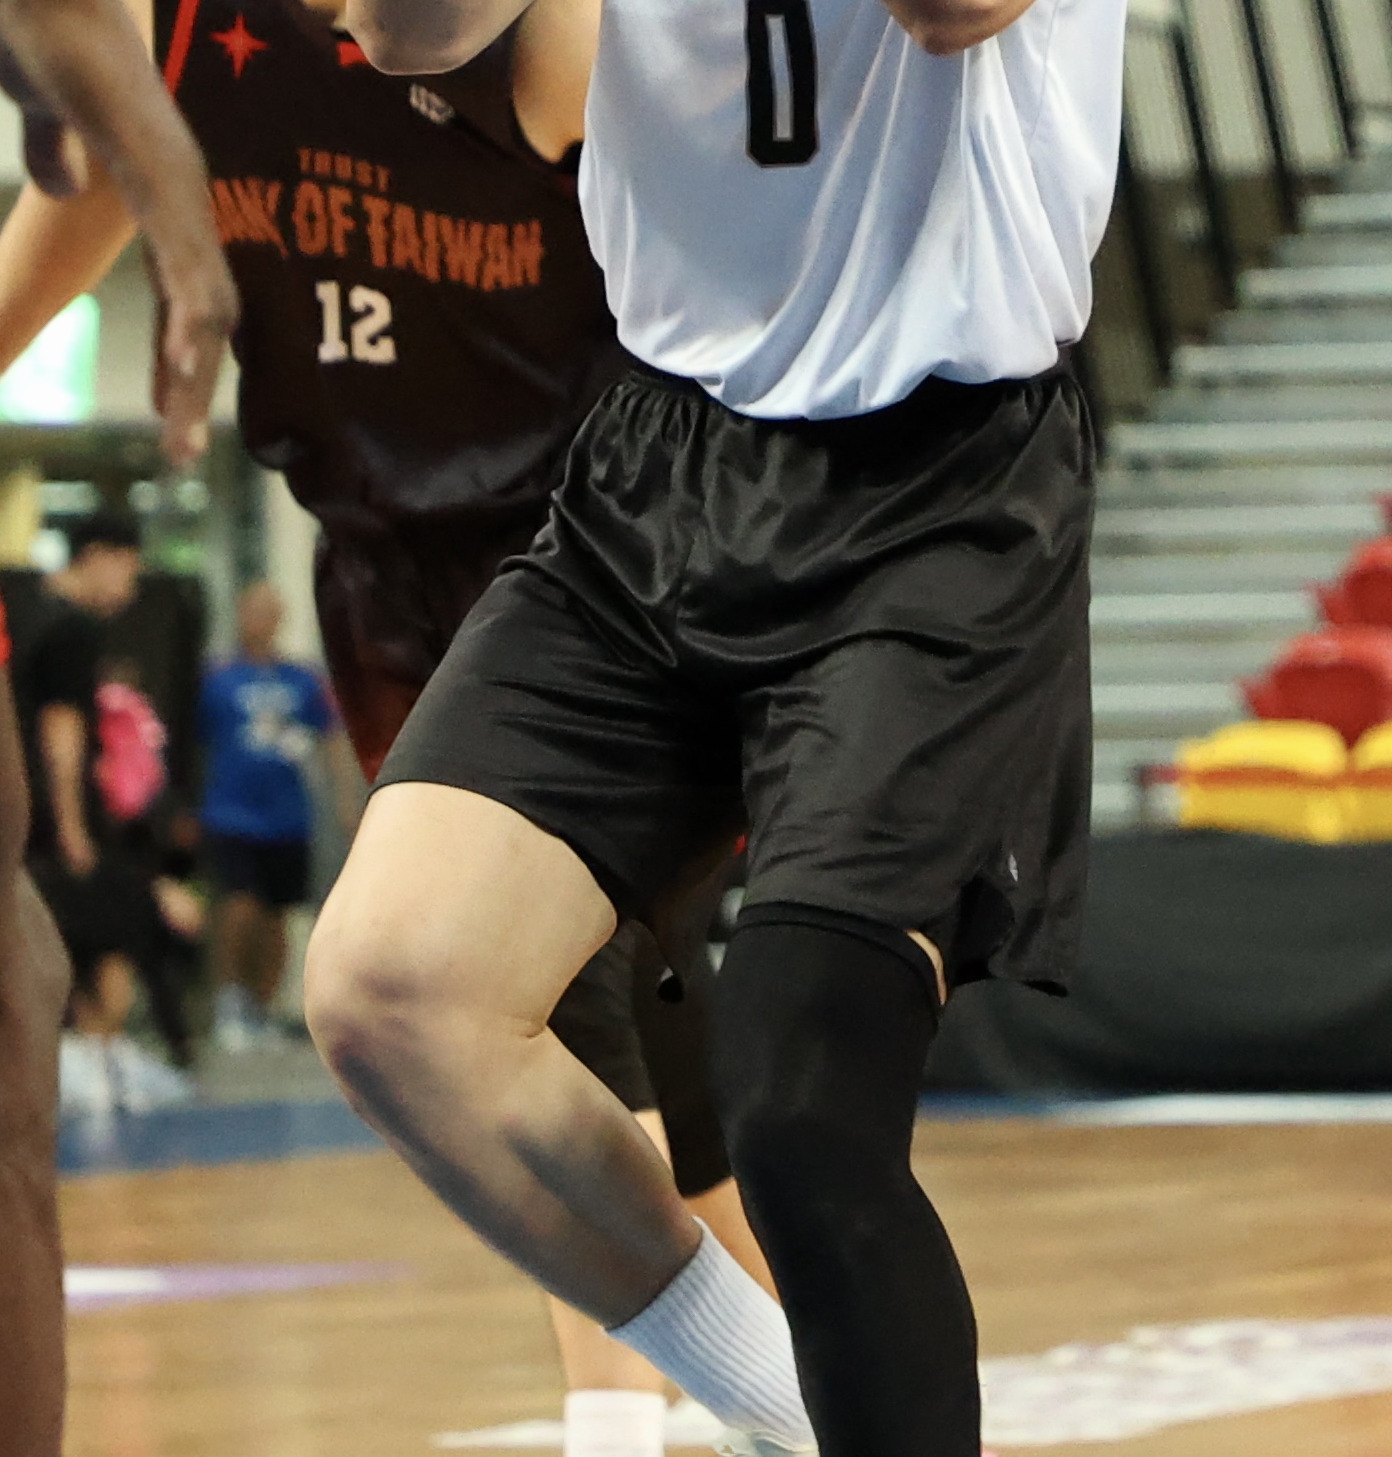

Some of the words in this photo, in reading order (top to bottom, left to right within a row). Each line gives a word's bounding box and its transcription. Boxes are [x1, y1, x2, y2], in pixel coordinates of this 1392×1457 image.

[292, 179, 357, 258] OF
[362, 194, 545, 293] TAIWAN
[316, 280, 397, 365] 12
